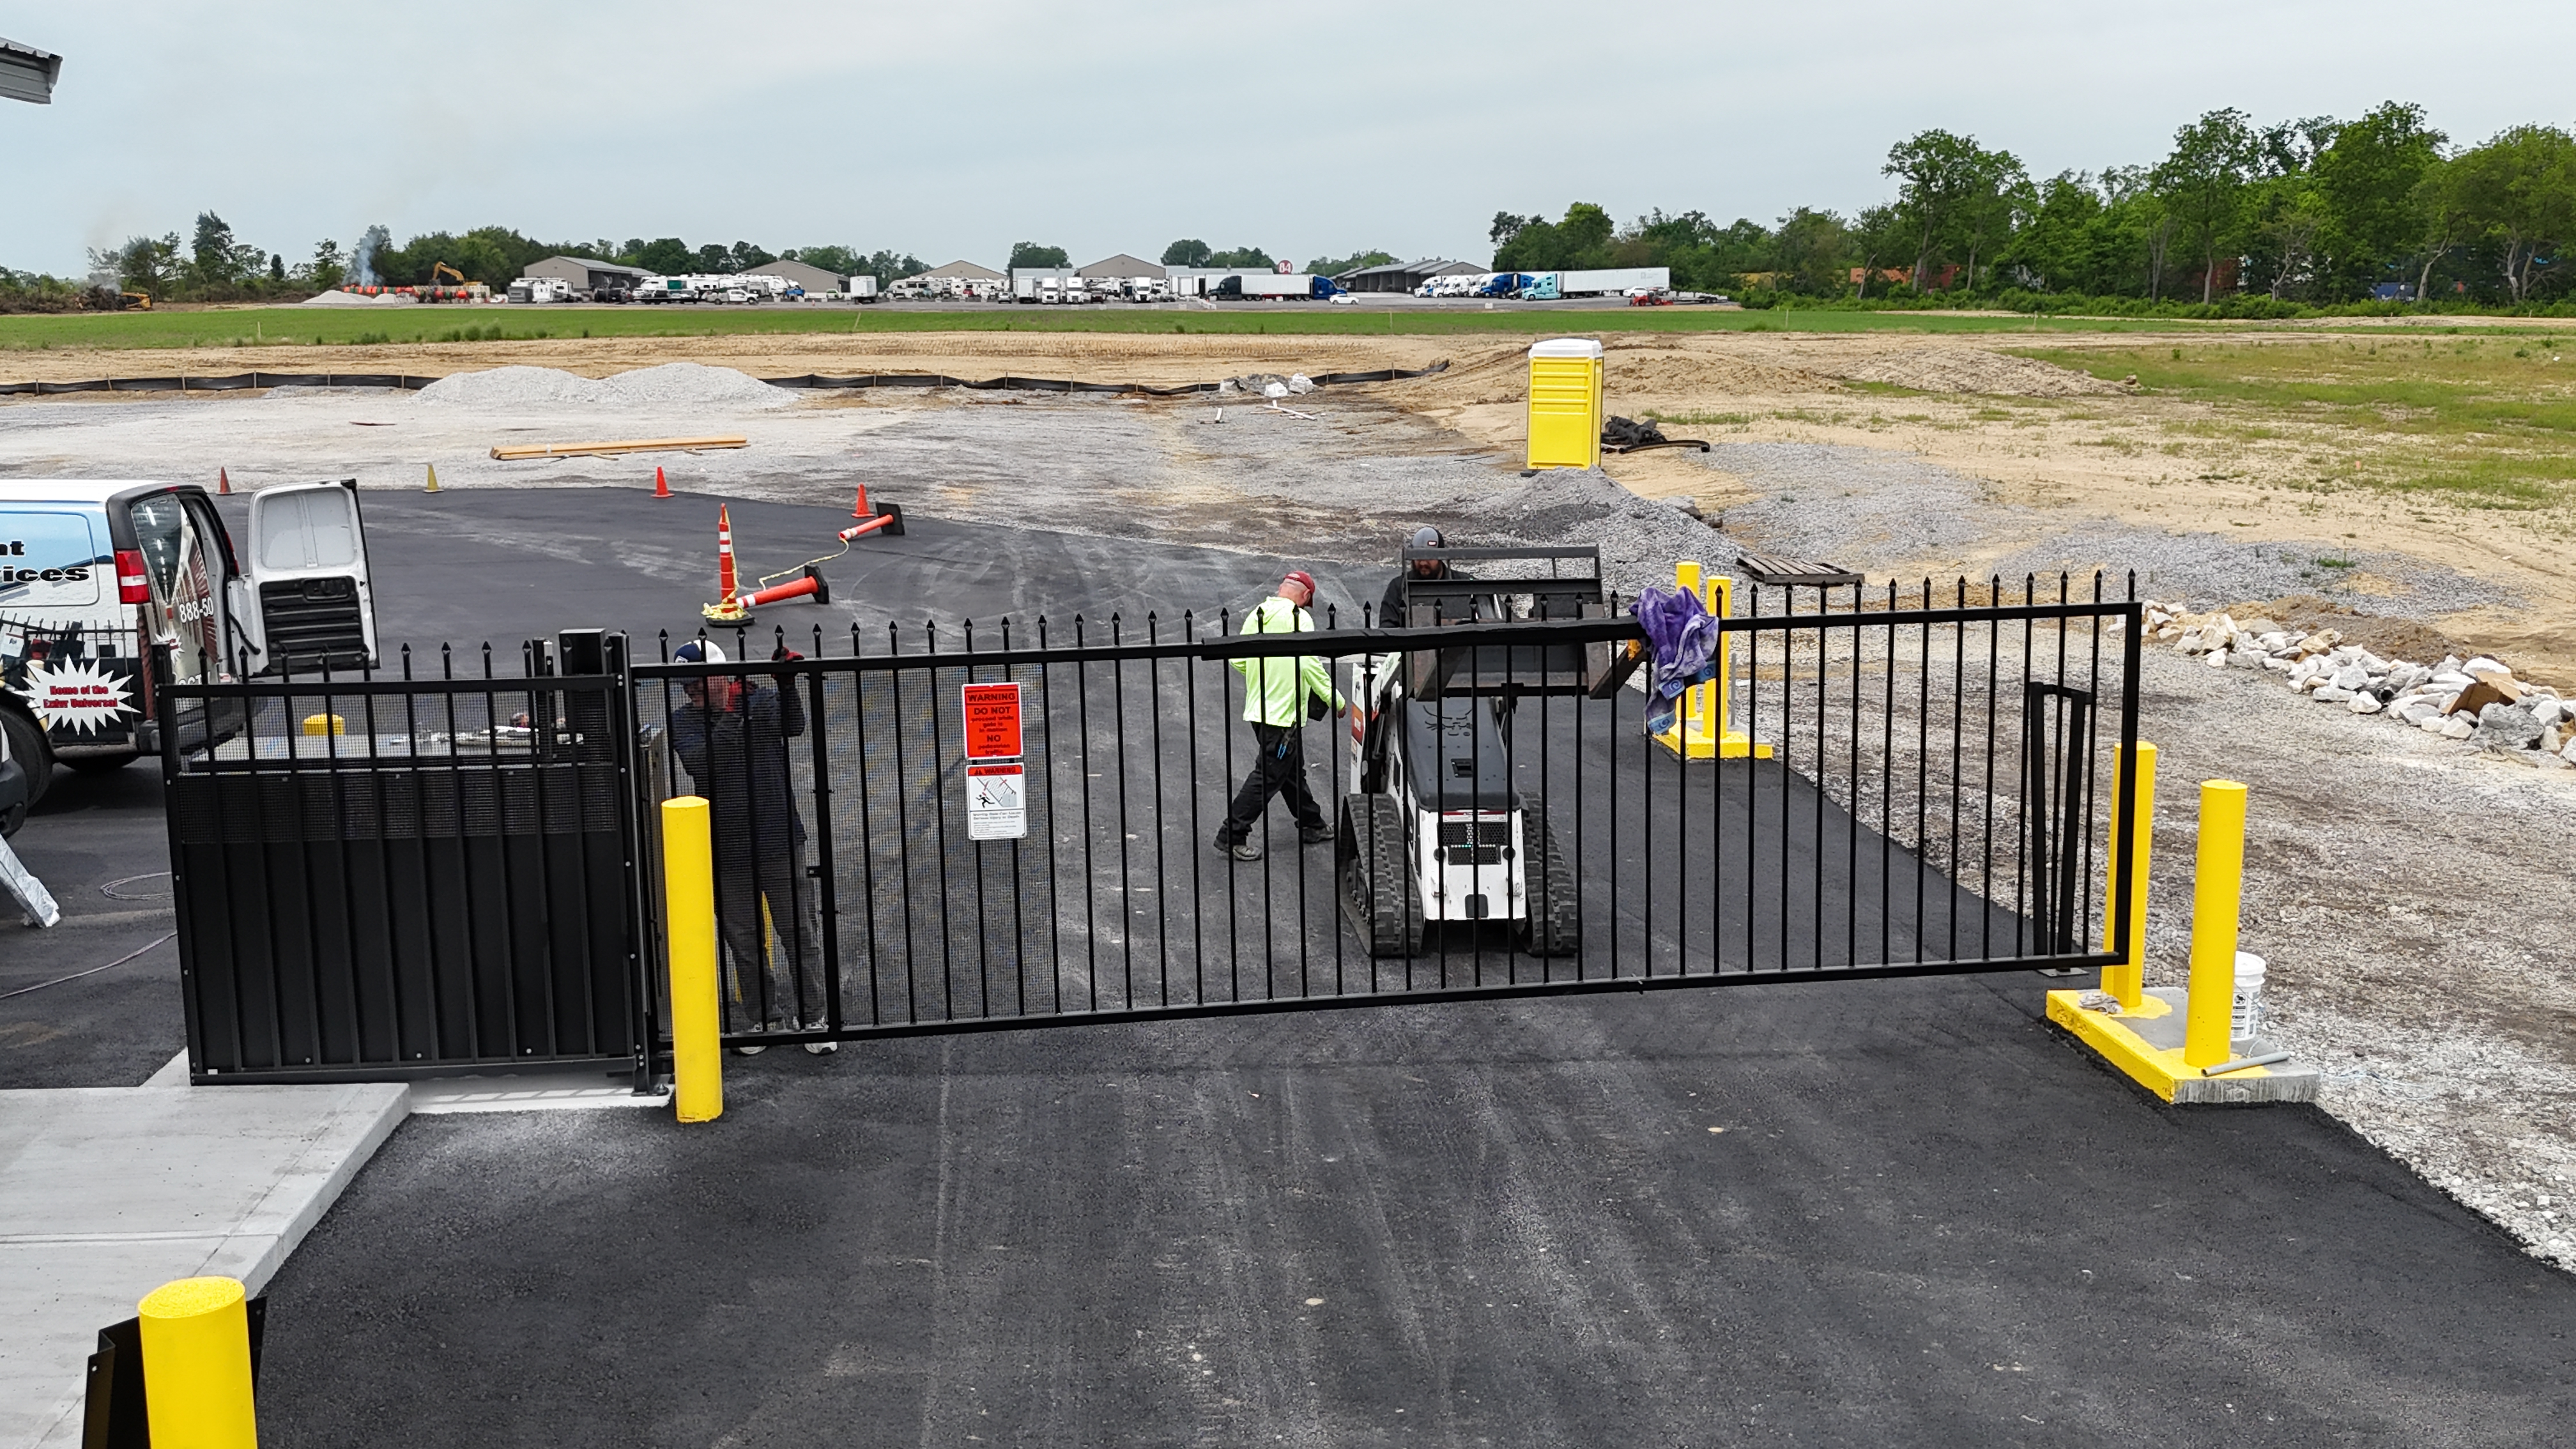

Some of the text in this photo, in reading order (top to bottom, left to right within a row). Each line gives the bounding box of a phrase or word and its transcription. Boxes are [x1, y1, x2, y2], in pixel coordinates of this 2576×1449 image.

[1279, 262, 1291, 273] 84
[0, 565, 89, 581] ices
[50, 685, 109, 695] Home of the
[967, 693, 1015, 702] WARNING
[70, 698, 118, 708] Universal
